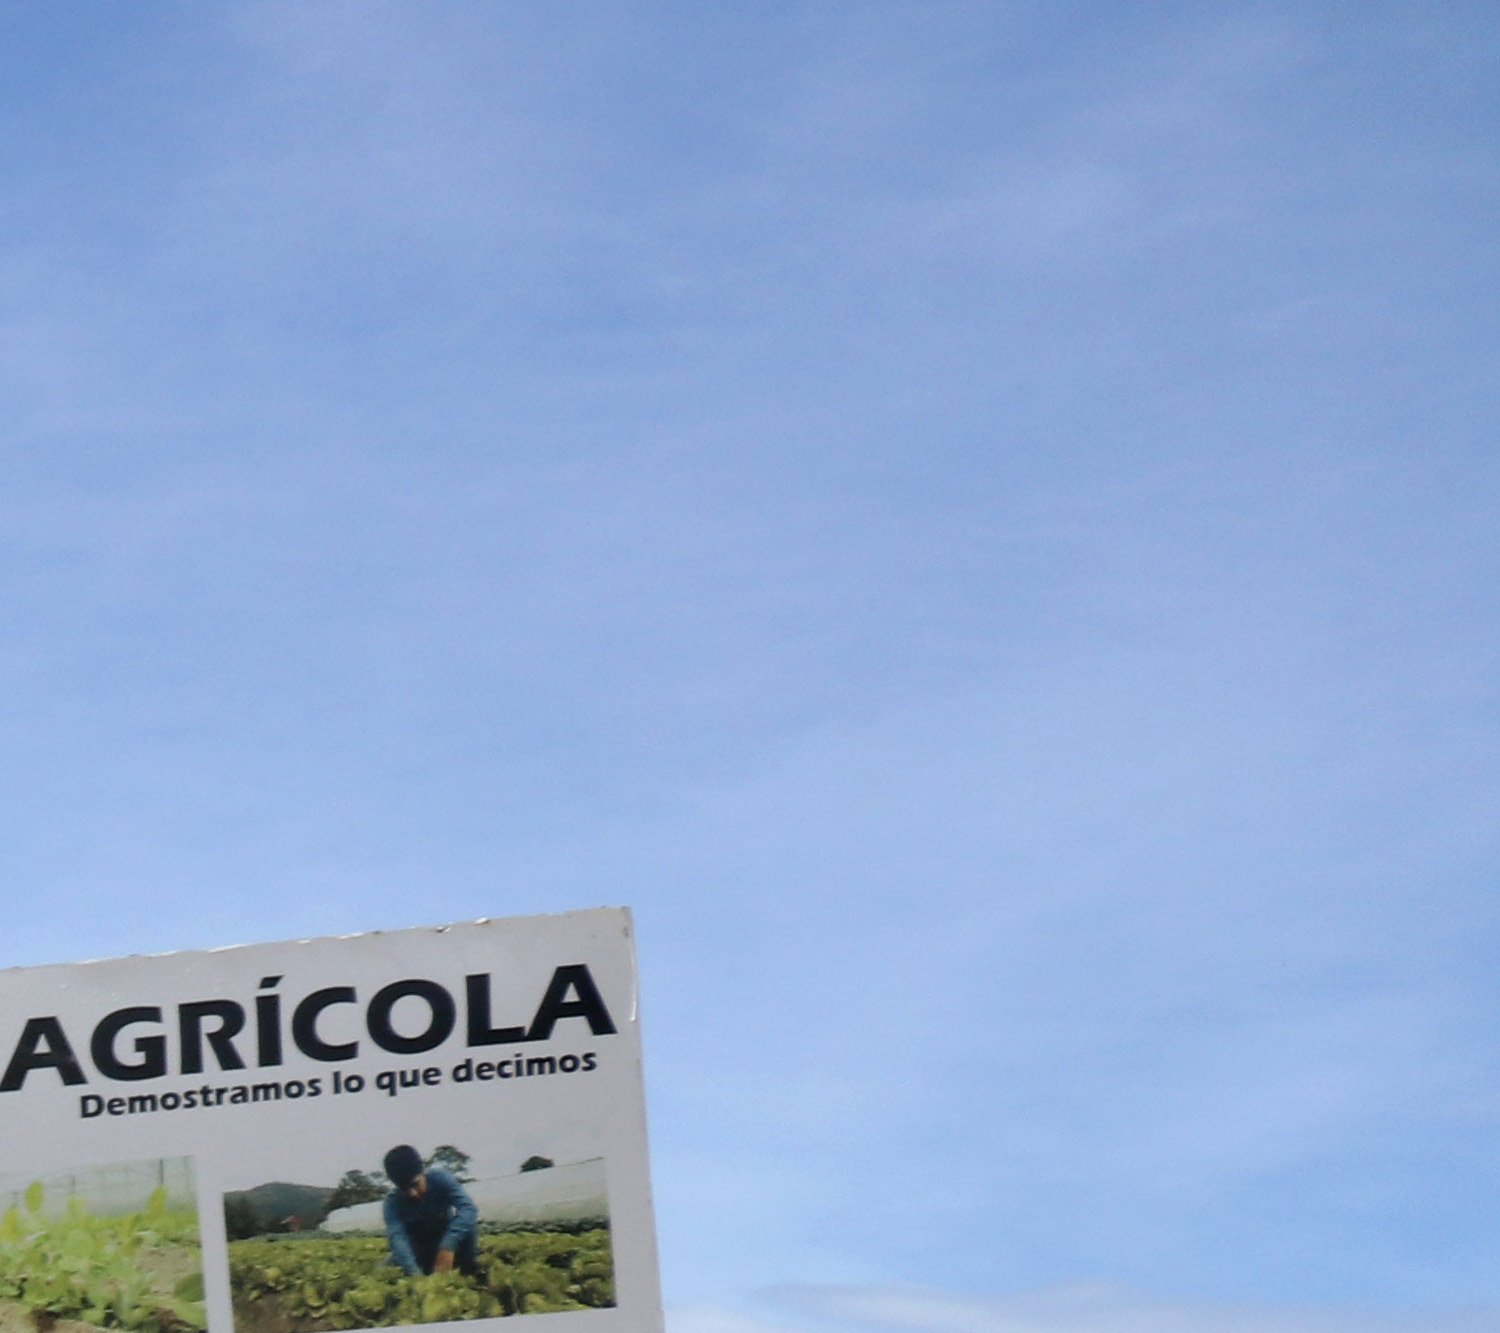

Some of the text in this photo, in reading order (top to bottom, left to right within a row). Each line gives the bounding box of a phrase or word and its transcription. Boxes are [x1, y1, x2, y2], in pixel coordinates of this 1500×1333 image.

[80, 1051, 598, 1119] Demostramos lo que decimos
